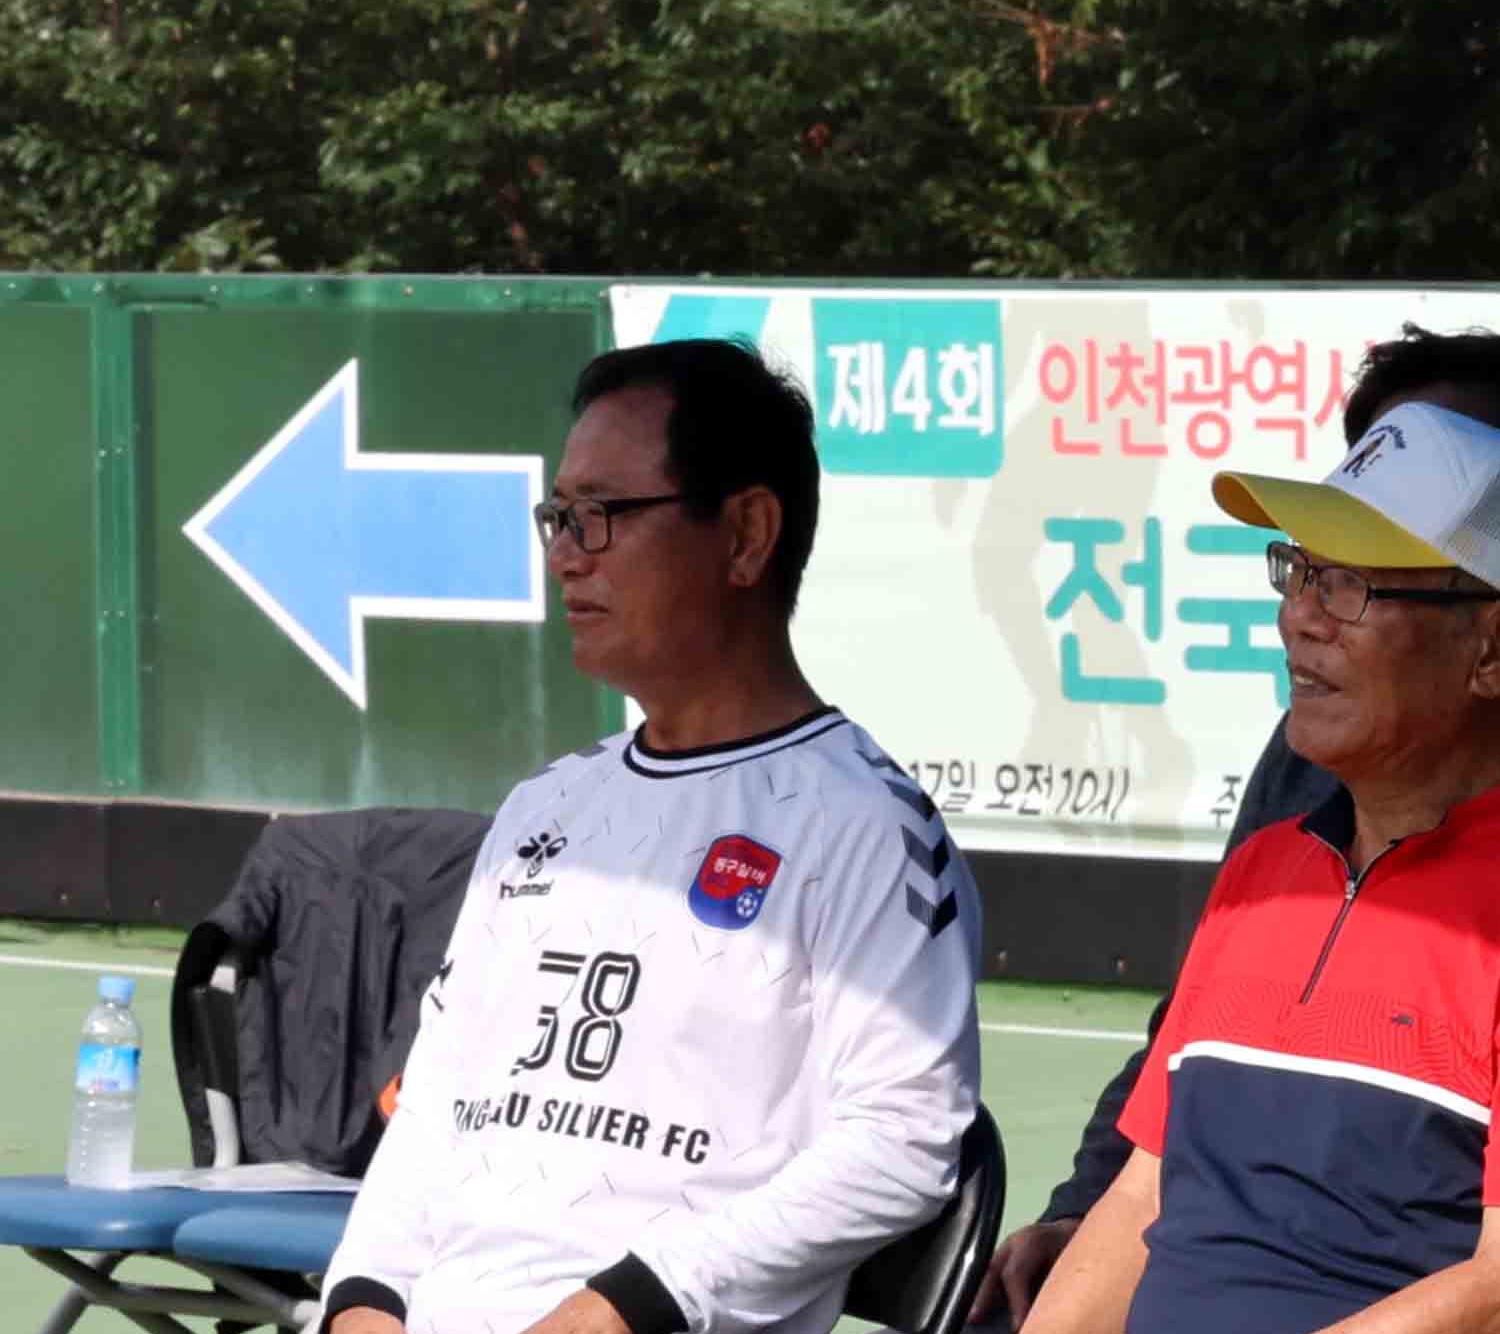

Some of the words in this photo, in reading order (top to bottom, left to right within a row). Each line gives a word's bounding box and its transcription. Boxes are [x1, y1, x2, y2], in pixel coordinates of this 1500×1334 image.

[826, 341, 996, 438] 제4회
[1043, 516, 1293, 710] 전국
[537, 1098, 650, 1151] SILVER
[661, 1123, 712, 1165] FC
